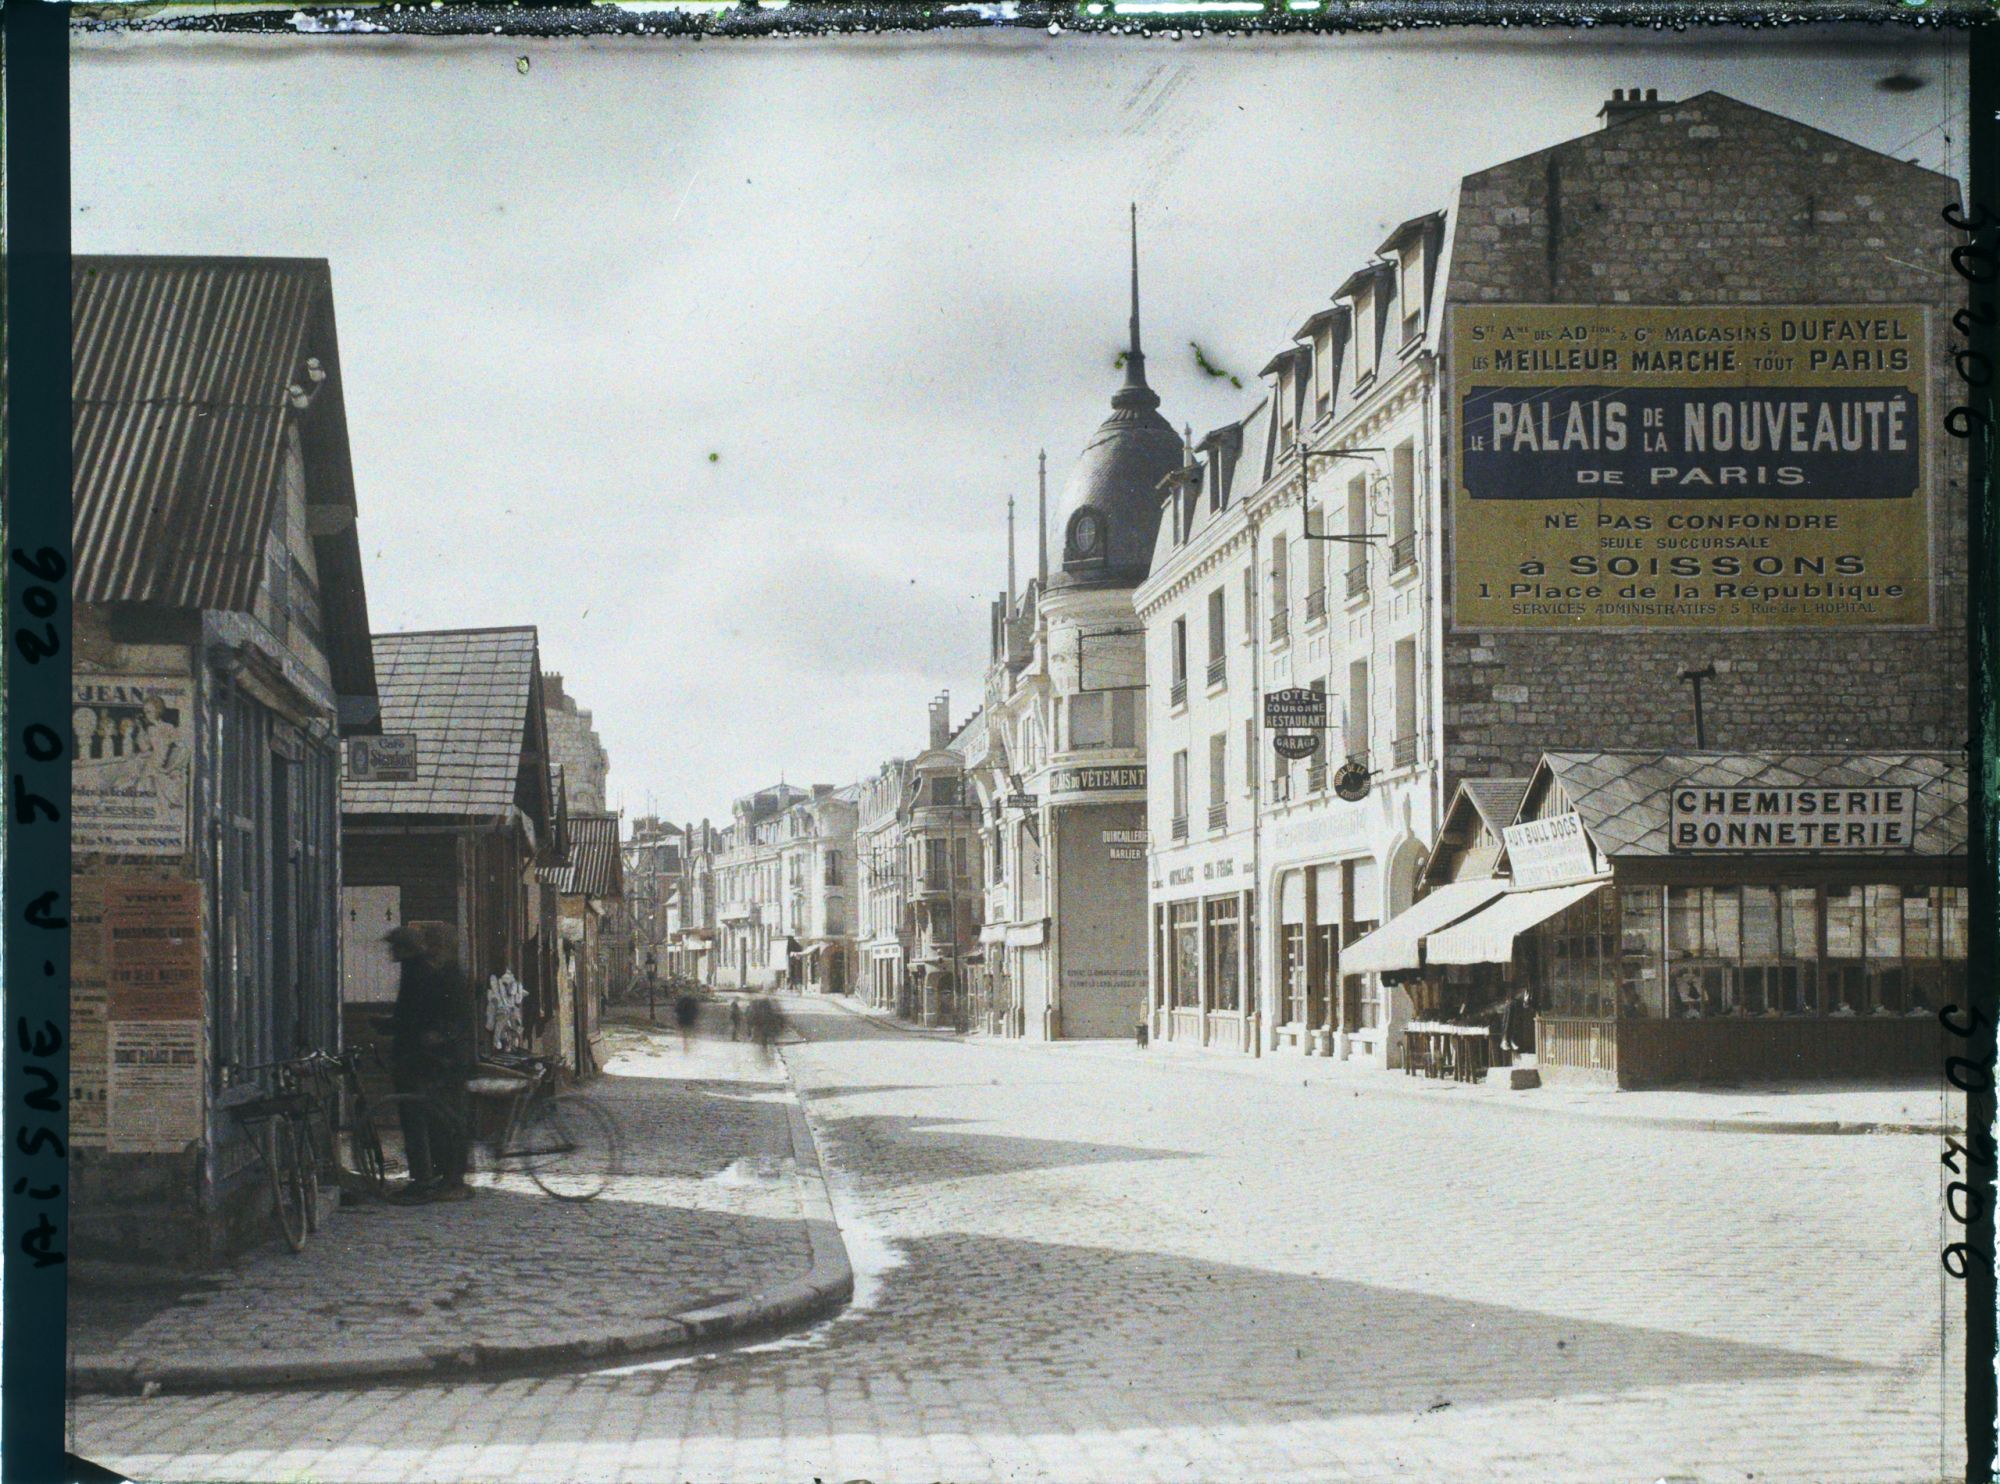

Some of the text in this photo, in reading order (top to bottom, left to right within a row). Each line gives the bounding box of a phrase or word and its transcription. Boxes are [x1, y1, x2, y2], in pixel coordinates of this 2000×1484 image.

[1664, 327, 1772, 342] MAGASINS
[1781, 320, 1909, 342] DUFAYEL
[1495, 348, 1618, 371] MEILLEUR
[1753, 357, 1794, 371] TOUT
[1810, 349, 1910, 371] PARIS
[1471, 395, 1908, 453] LE PALAIS DE LA NOUVEAUTÉ
[1576, 466, 1805, 485] DE PARIS
[1545, 514, 1839, 530] NE PAS CONFONDRE
[1600, 537, 1769, 549] SEULE SUCCURSALE
[1569, 555, 1866, 577] SOISSONS
[1510, 583, 1602, 599] Place
[1618, 583, 1657, 599] de
[1674, 583, 1700, 599] la
[1715, 582, 1904, 602] République
[1512, 603, 1586, 615] SERVICES
[1596, 602, 1716, 615] ADMINISTRATIFS
[1751, 603, 1777, 614] Rue
[1781, 603, 1797, 614] de
[1266, 715, 1326, 728] RESTAURANT
[1276, 738, 1316, 750] GARAGE
[1677, 791, 1904, 813] CHEMISERIE
[1524, 822, 1550, 844] BULL
[1678, 822, 1903, 844] BONNETERIE
